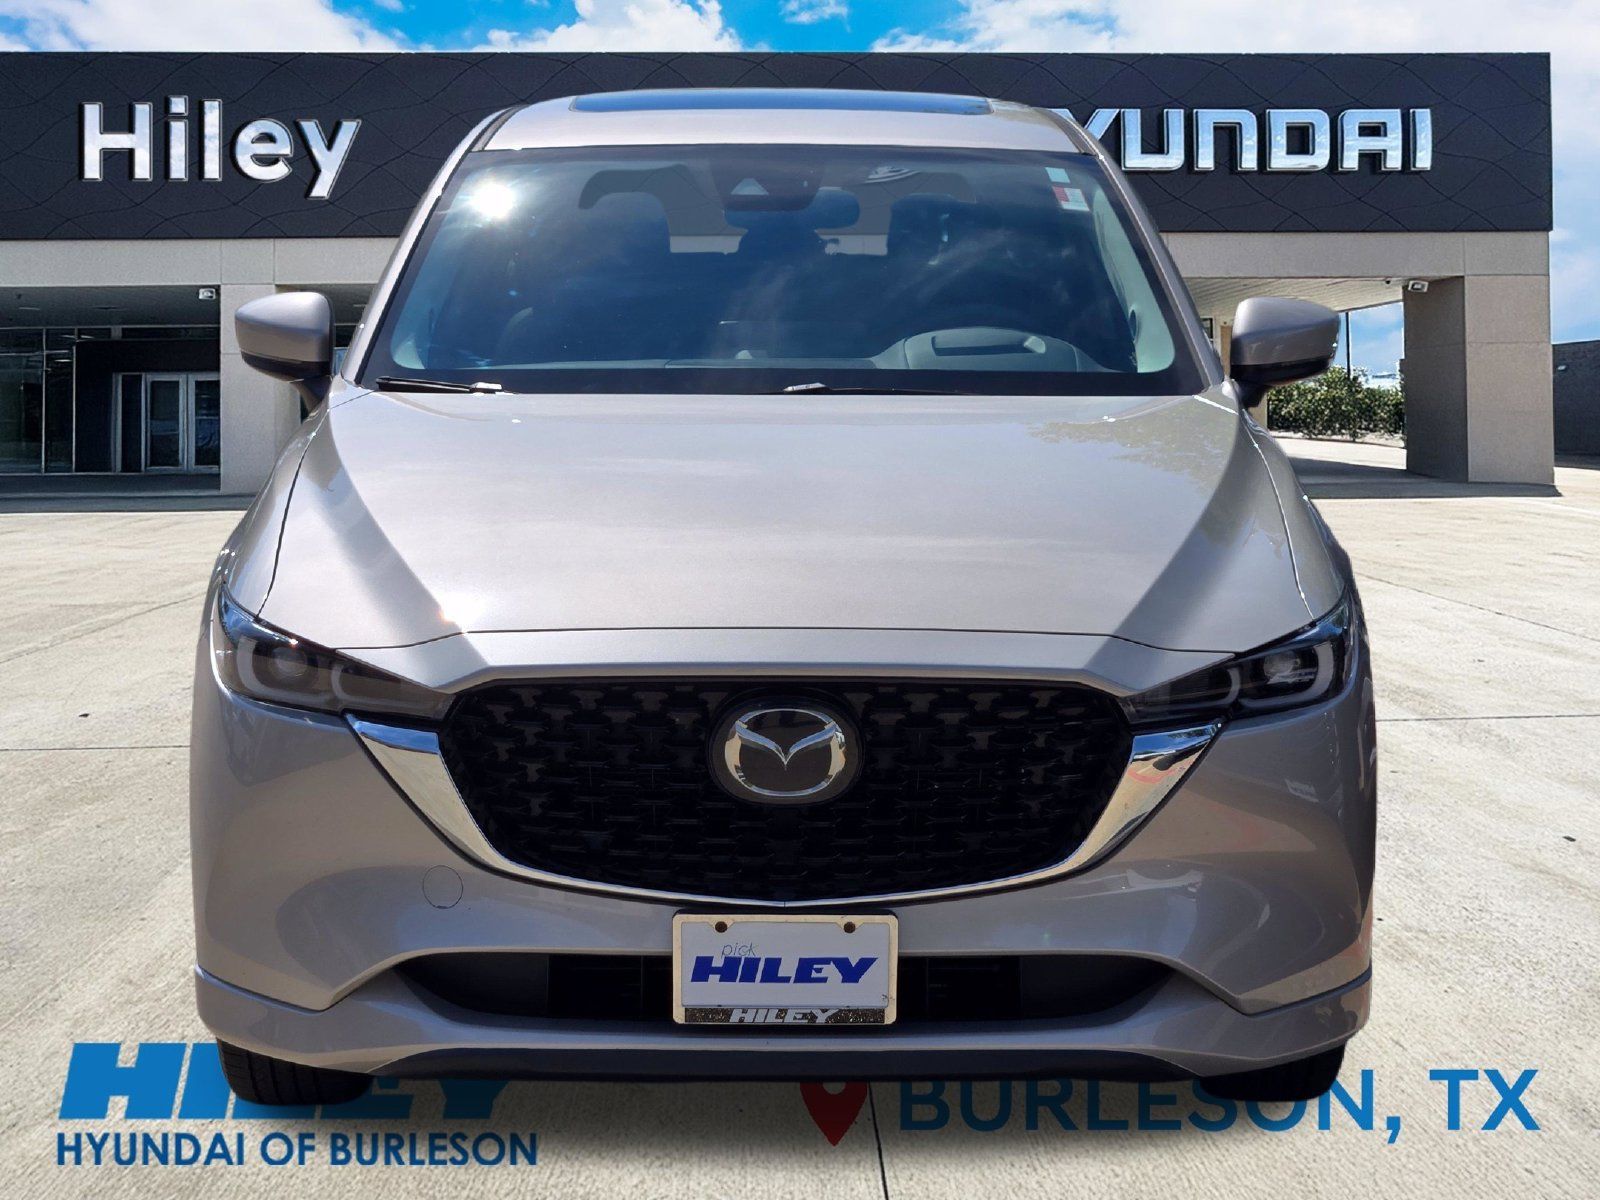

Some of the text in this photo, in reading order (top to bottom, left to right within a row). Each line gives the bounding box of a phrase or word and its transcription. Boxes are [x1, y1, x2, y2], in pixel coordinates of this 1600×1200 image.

[81, 95, 362, 199] Hiley
[690, 956, 879, 984] HILEY
[729, 1008, 841, 1024] HILEY
